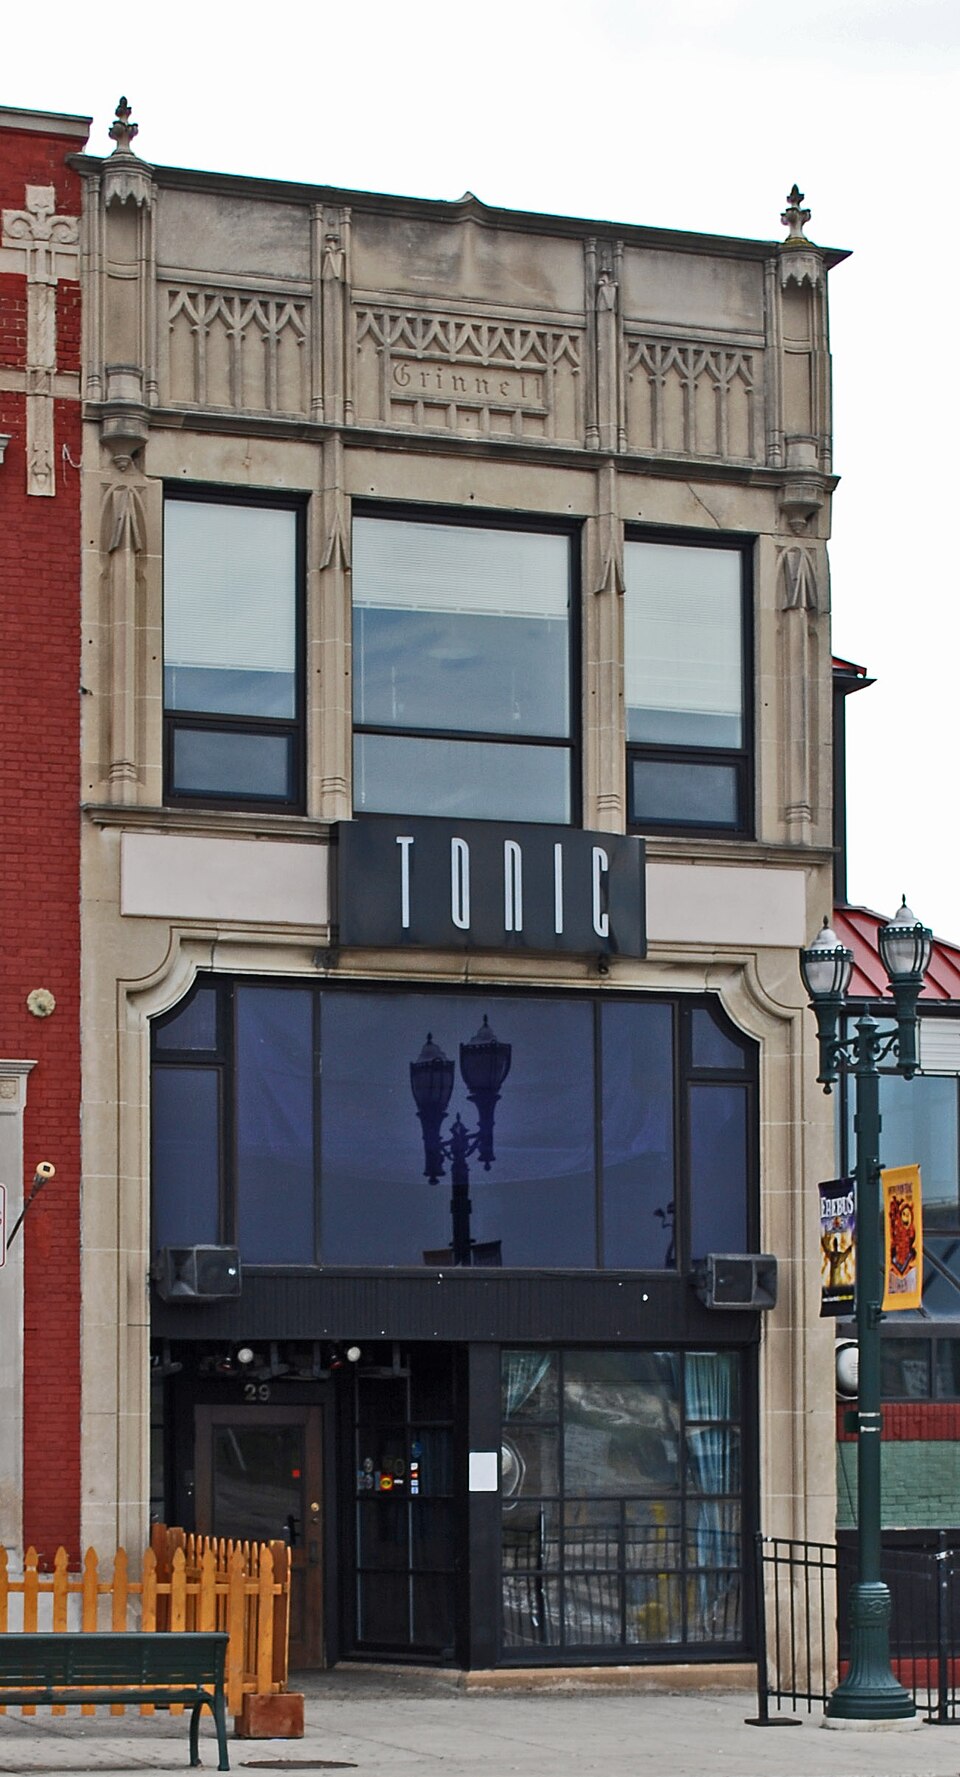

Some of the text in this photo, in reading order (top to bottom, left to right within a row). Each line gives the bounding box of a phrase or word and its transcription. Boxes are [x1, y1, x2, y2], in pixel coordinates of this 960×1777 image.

[393, 363, 543, 400] Grinnell
[396, 836, 609, 938] TONIC
[243, 1383, 271, 1401] 29
